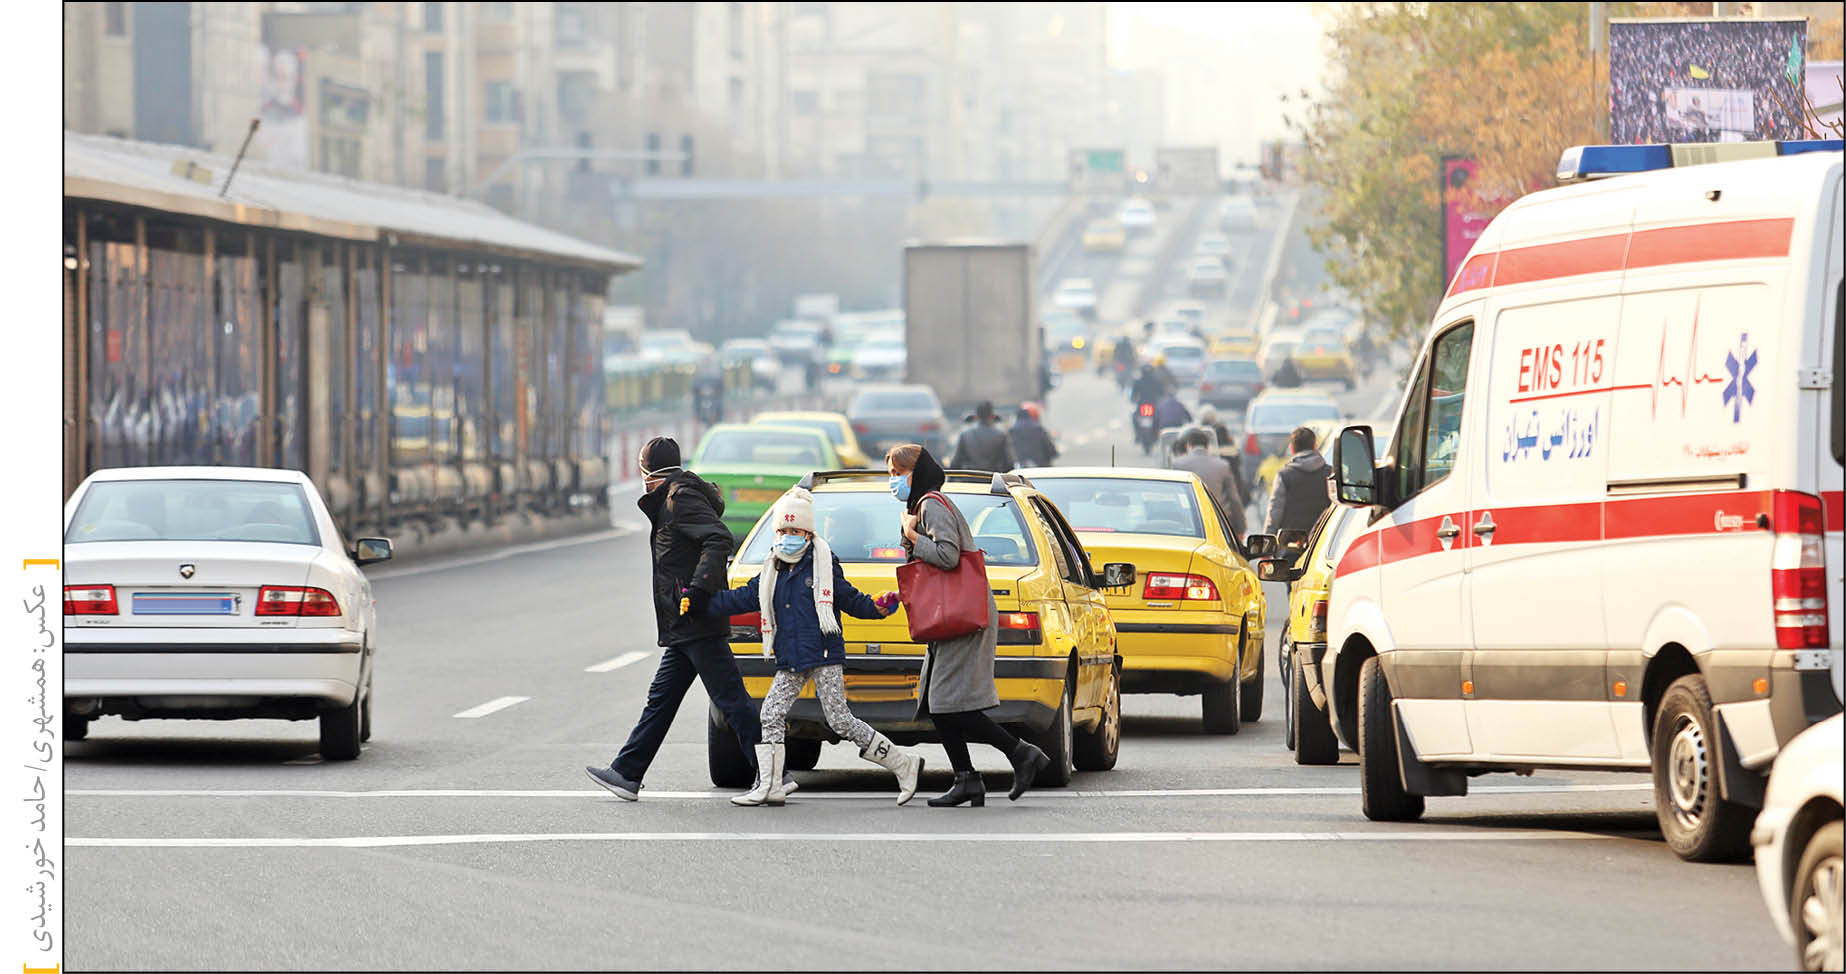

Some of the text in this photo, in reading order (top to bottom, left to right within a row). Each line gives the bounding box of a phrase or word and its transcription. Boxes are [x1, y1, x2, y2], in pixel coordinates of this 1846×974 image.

[1518, 338, 1605, 393] EMS 115
[1502, 407, 1599, 463] اورژانس تهران
